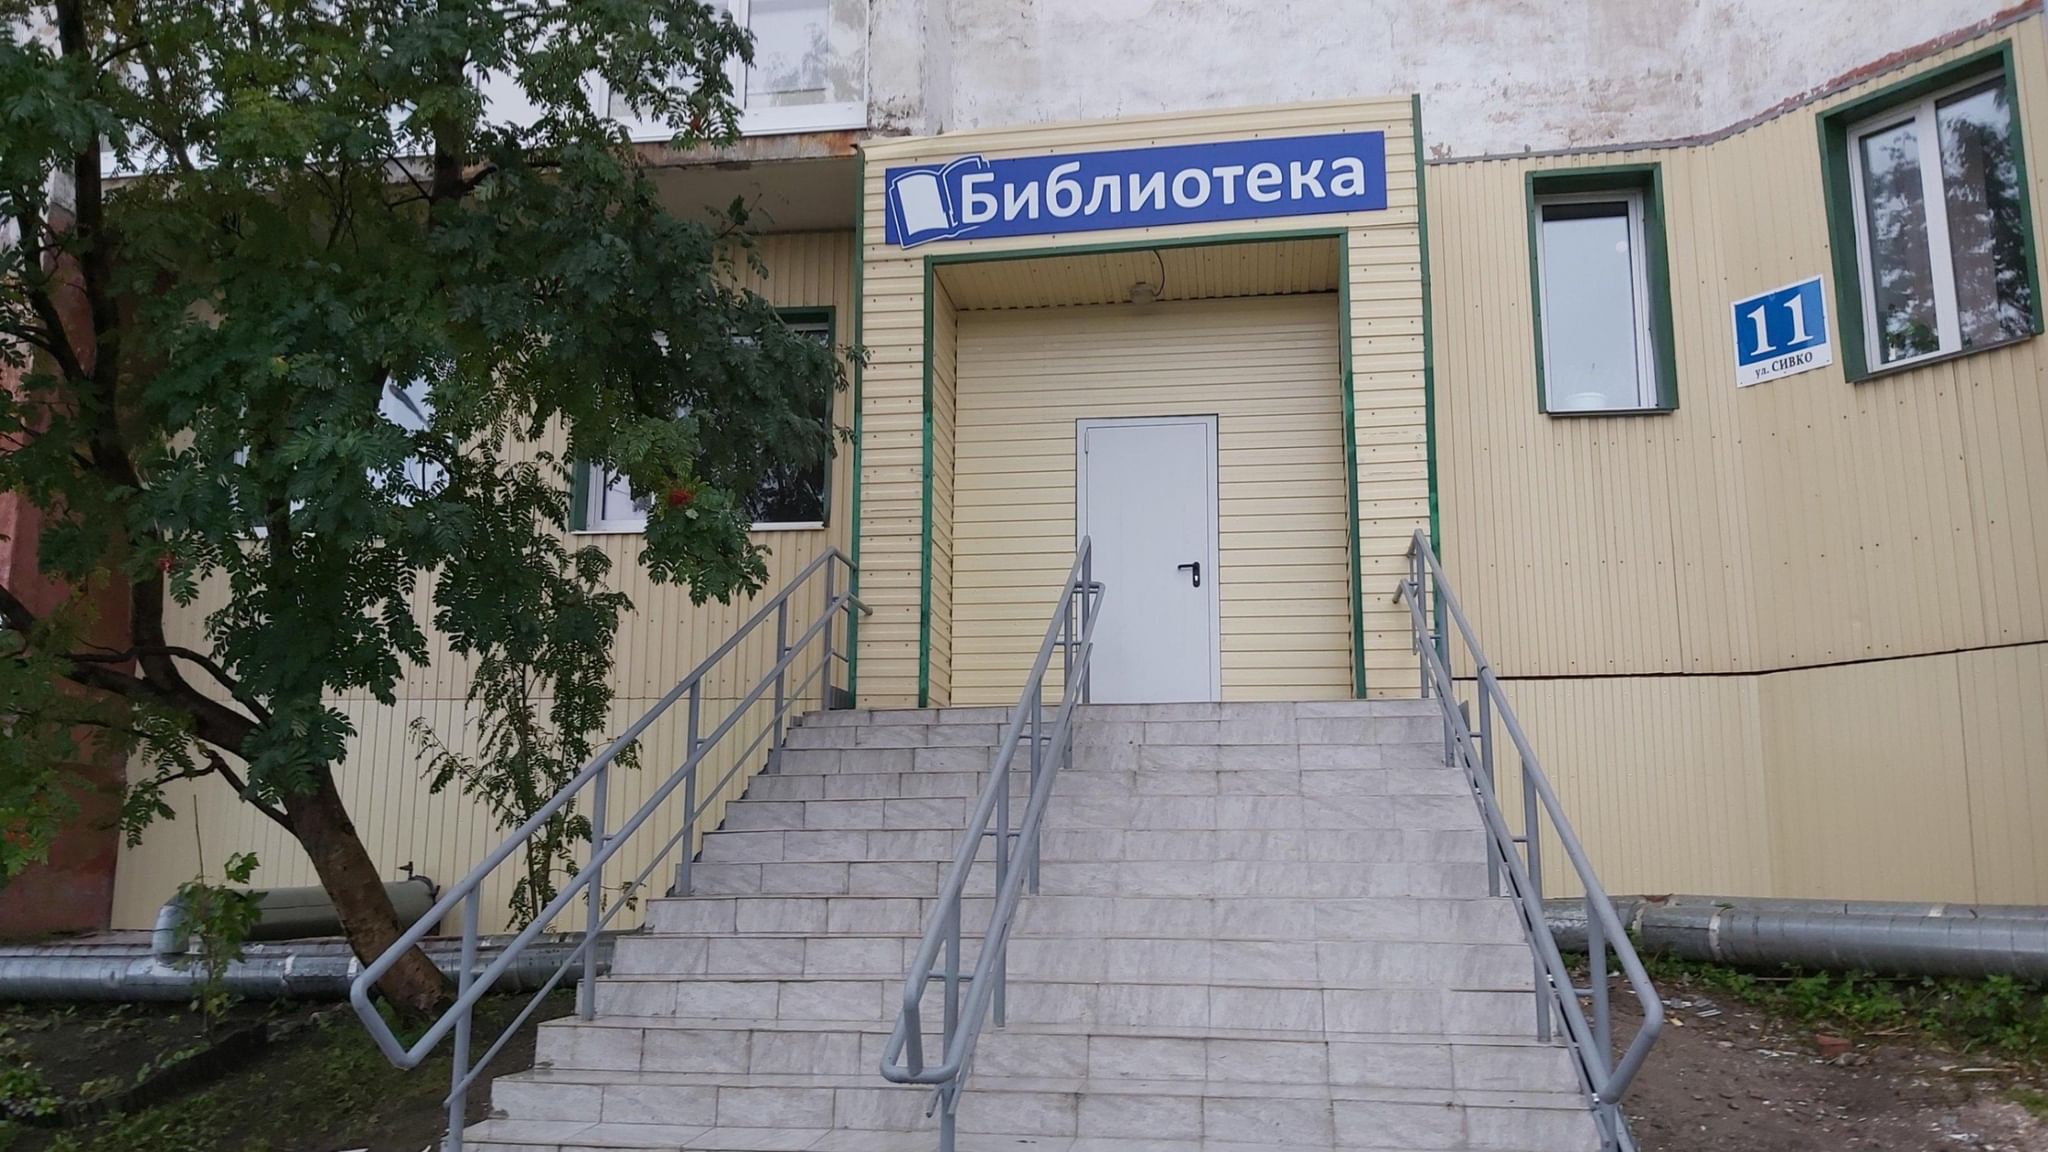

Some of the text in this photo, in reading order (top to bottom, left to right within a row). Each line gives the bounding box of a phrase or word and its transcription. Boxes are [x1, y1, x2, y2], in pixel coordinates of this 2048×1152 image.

[961, 155, 1365, 223] Библиотека
[1747, 294, 1814, 357] 11
[1755, 351, 1813, 379] ул. СИВКО
